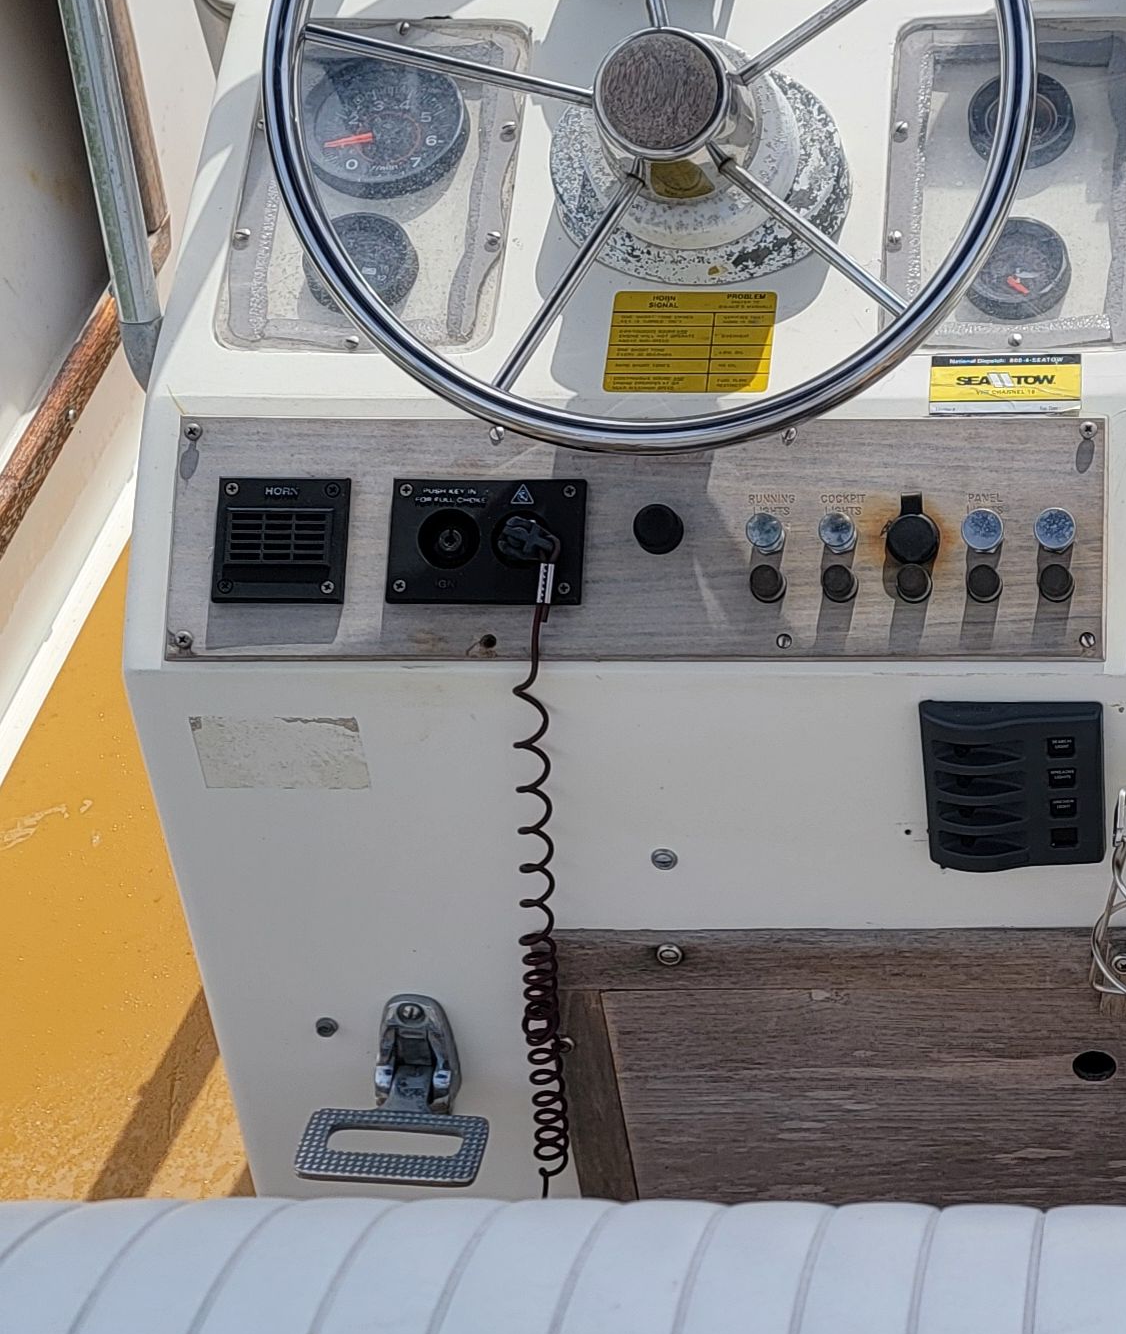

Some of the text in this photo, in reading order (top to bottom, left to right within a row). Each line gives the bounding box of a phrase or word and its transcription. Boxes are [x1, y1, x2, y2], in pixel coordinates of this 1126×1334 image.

[420, 112, 432, 123] 5
[425, 135, 438, 146] 6
[345, 159, 359, 170] 0
[410, 157, 421, 168] 7
[956, 375, 1056, 386] SEA TOW
[265, 487, 298, 496] HORN
[748, 494, 796, 504] RUNNING
[820, 494, 866, 504] COCKPIT
[968, 493, 1004, 503] PANEL
